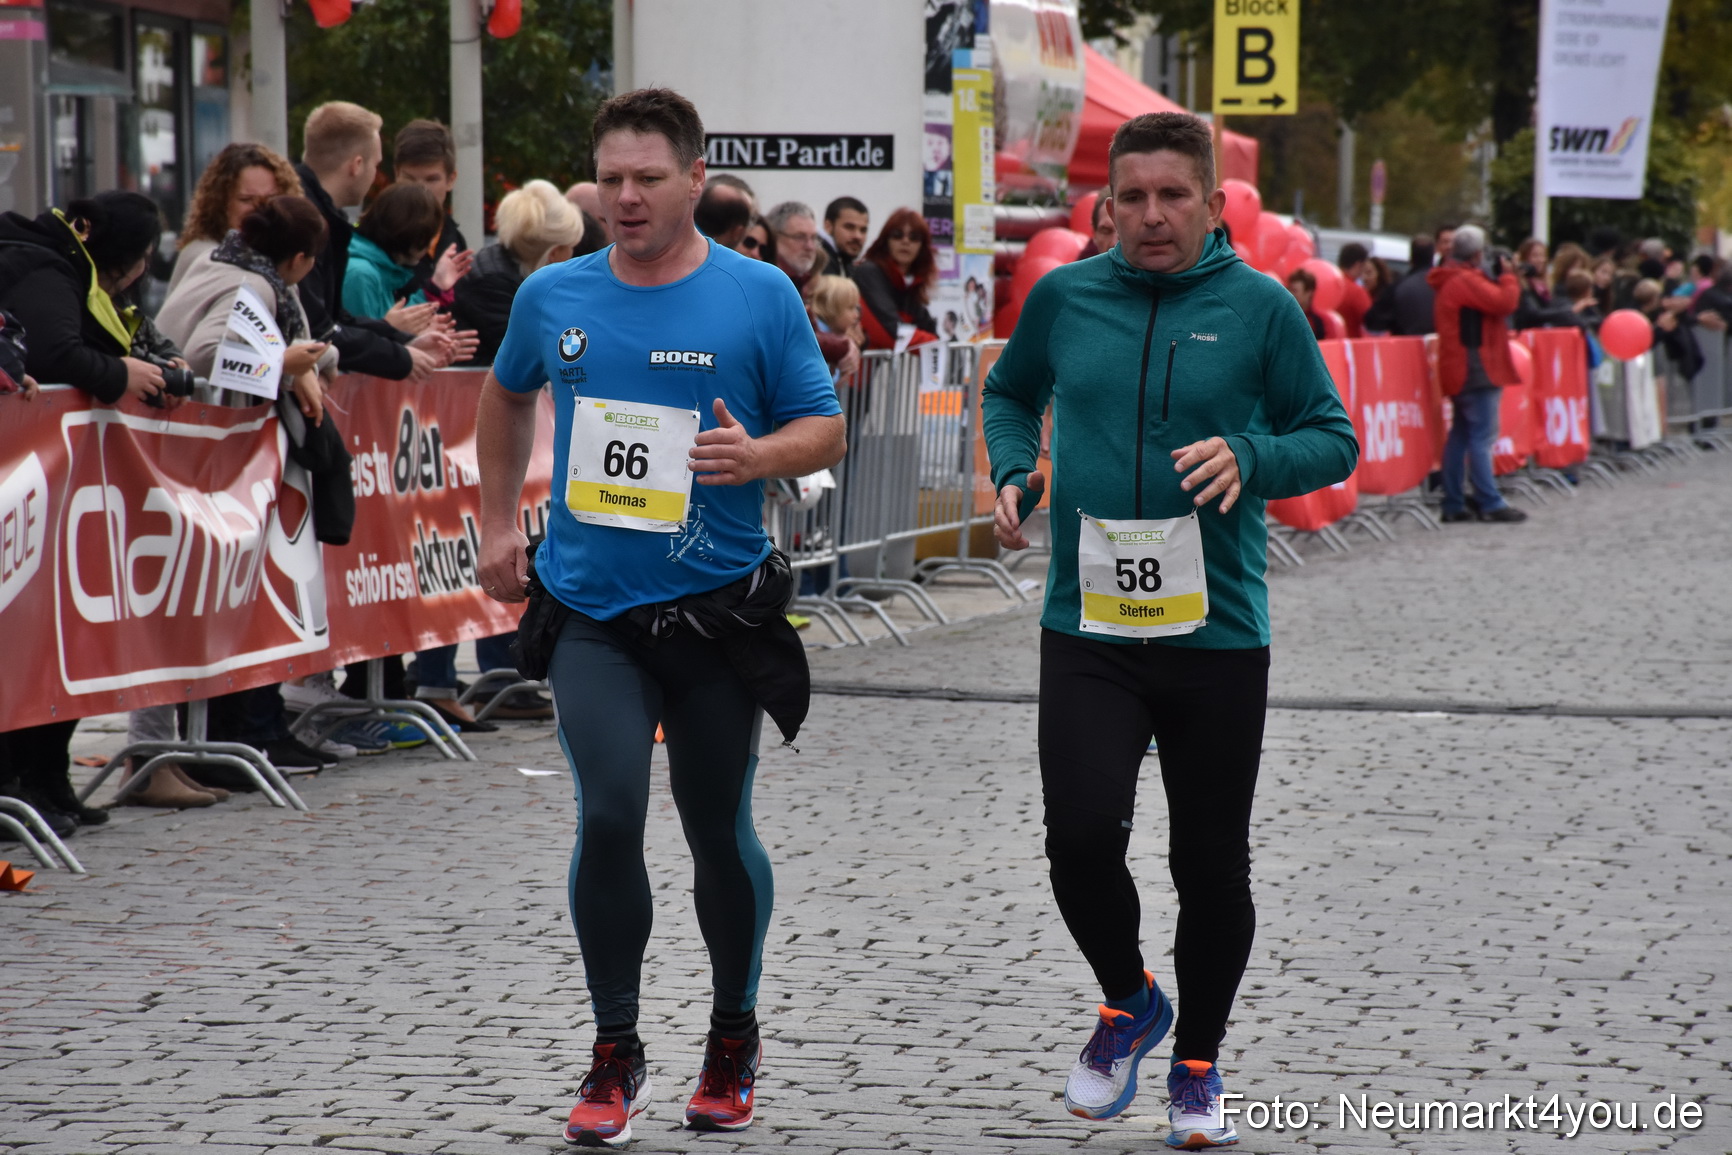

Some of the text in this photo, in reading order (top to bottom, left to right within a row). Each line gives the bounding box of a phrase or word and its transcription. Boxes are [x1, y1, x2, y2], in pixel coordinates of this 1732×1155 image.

[1225, 0, 1288, 15] Block
[1237, 27, 1276, 86] B
[1549, 126, 1610, 154] swn
[704, 138, 885, 167] MINI-Partl.de
[233, 301, 267, 332] swn
[221, 358, 253, 375] wn
[650, 350, 716, 367] BOCK
[615, 413, 660, 428] BOCK
[604, 440, 650, 480] 66
[599, 490, 647, 508] Thomas
[0, 488, 36, 584] EUE
[1119, 531, 1165, 542] BOCK
[1116, 557, 1162, 593] 58
[1119, 603, 1164, 618] Steffen
